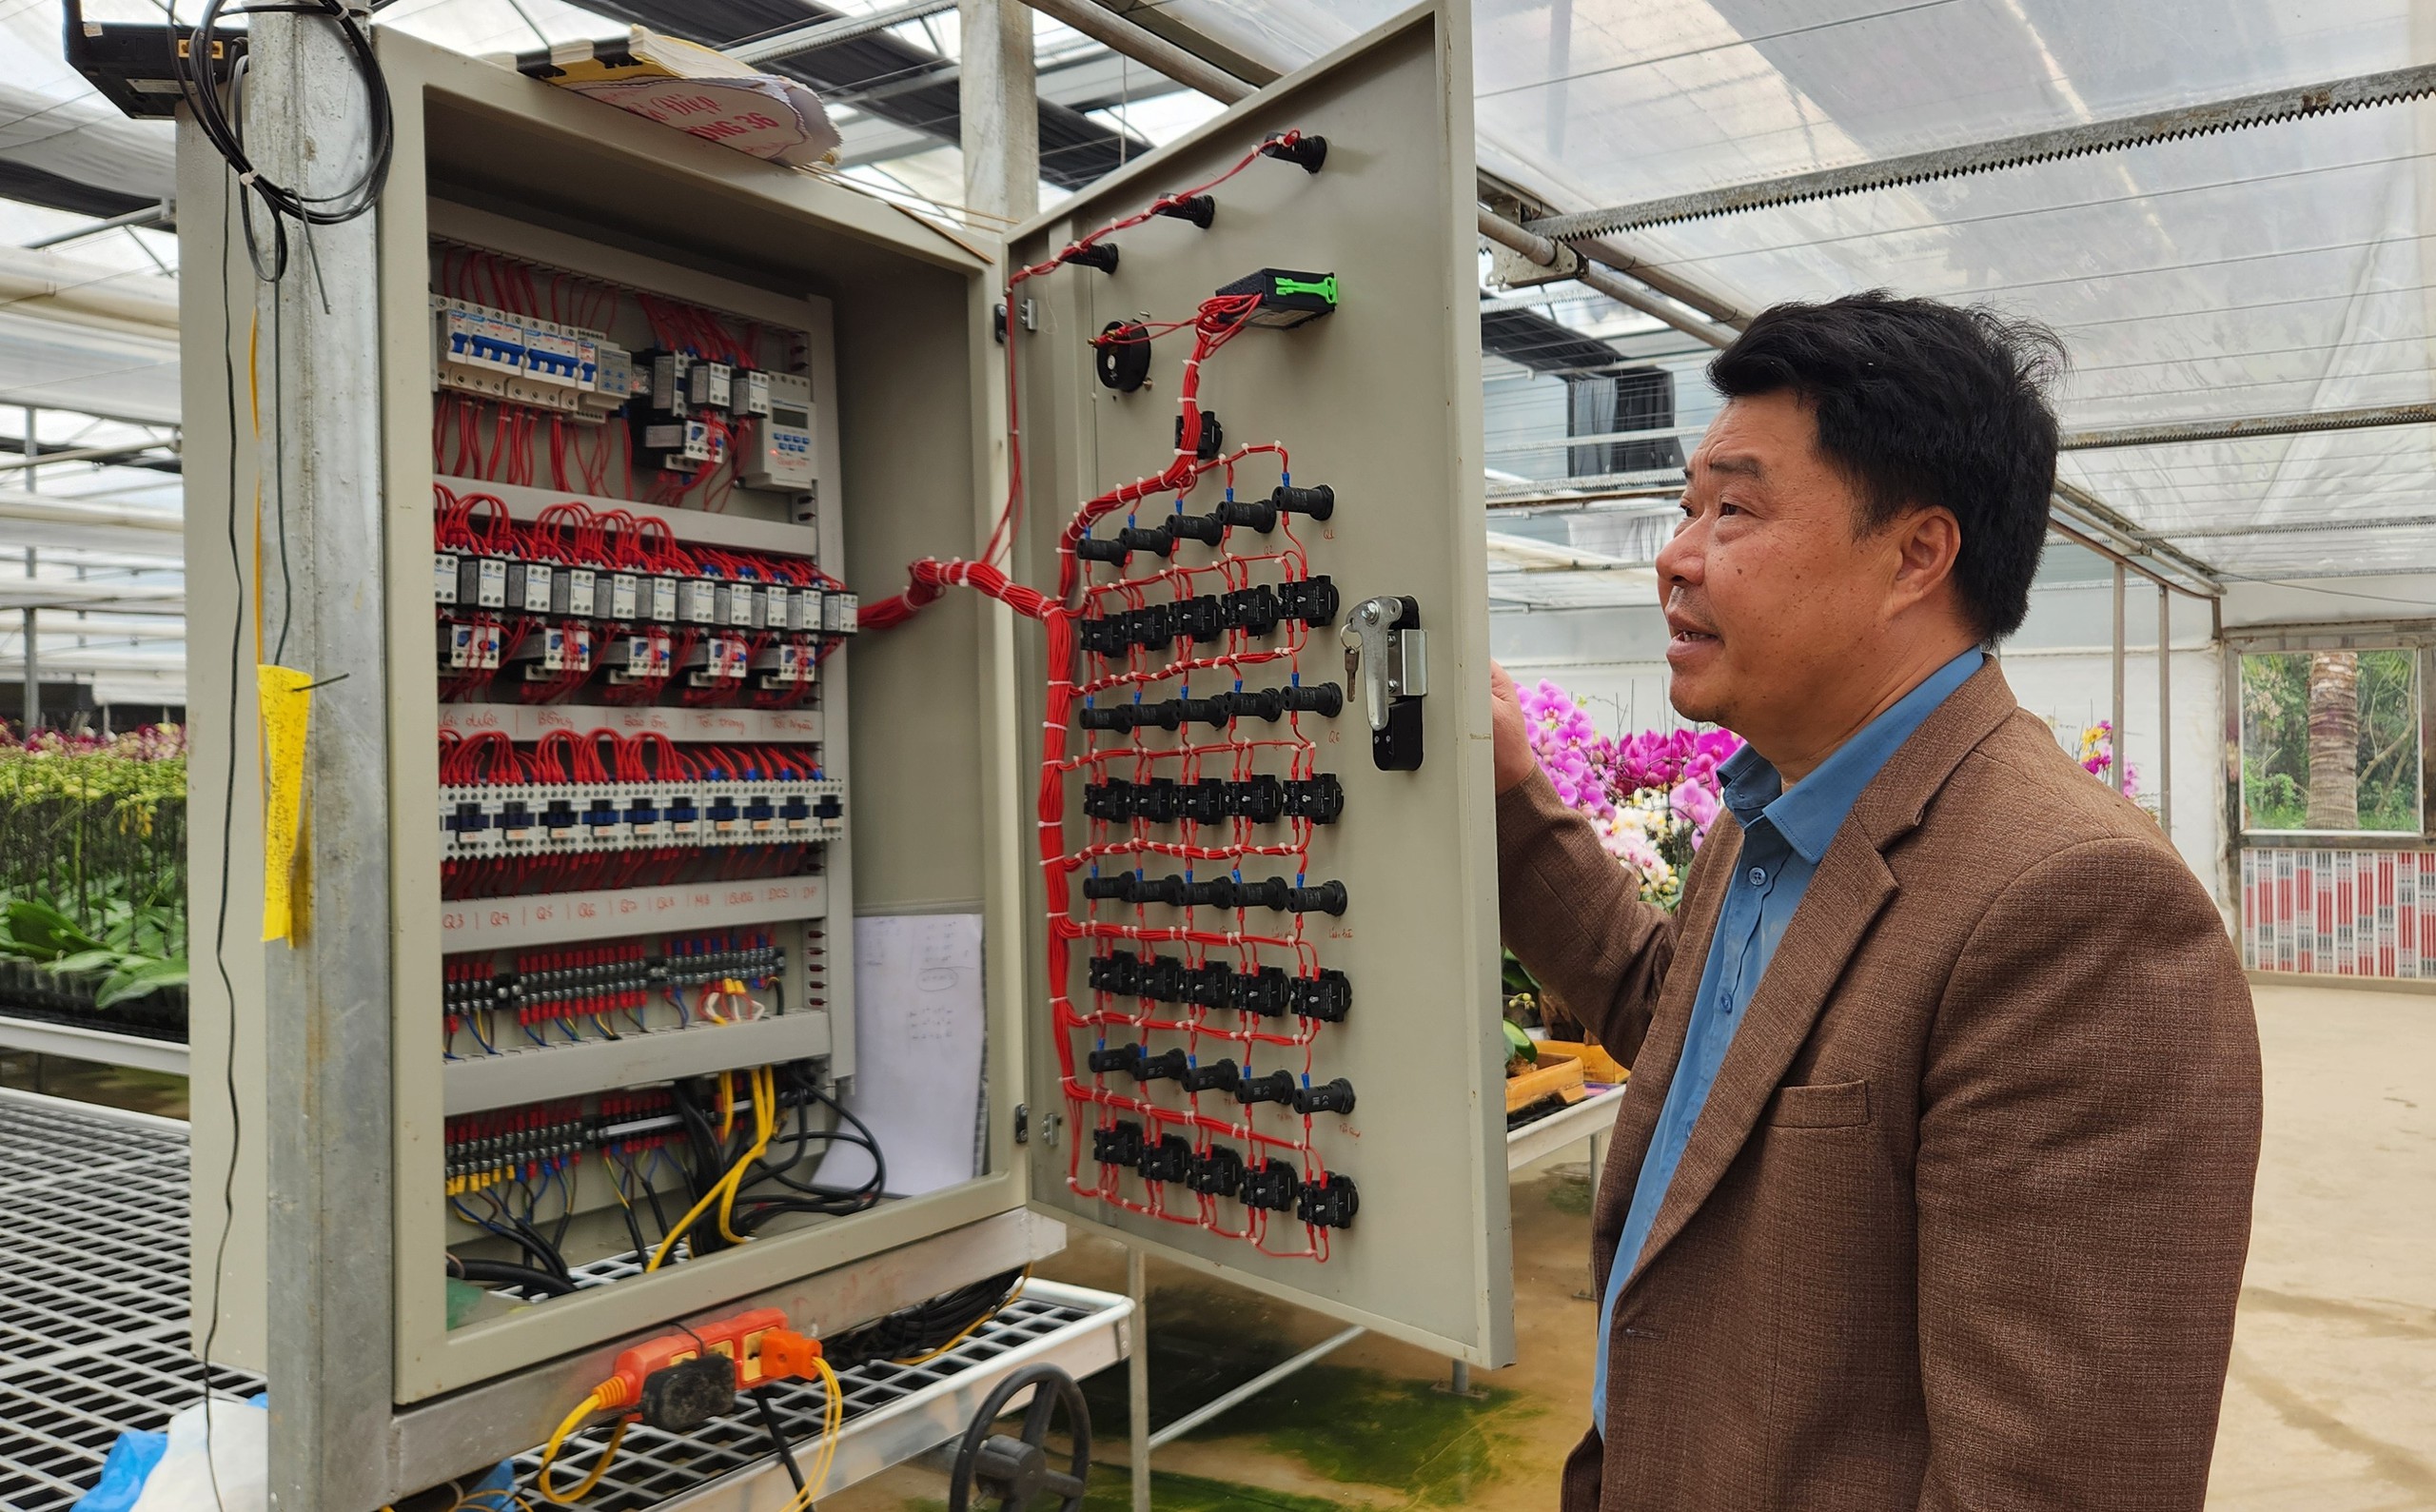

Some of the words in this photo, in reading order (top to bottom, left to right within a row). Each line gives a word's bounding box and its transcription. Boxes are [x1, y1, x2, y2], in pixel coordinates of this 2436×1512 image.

[734, 111, 780, 129] 36
[442, 913, 464, 929] Q3
[490, 912, 510, 927] Q4
